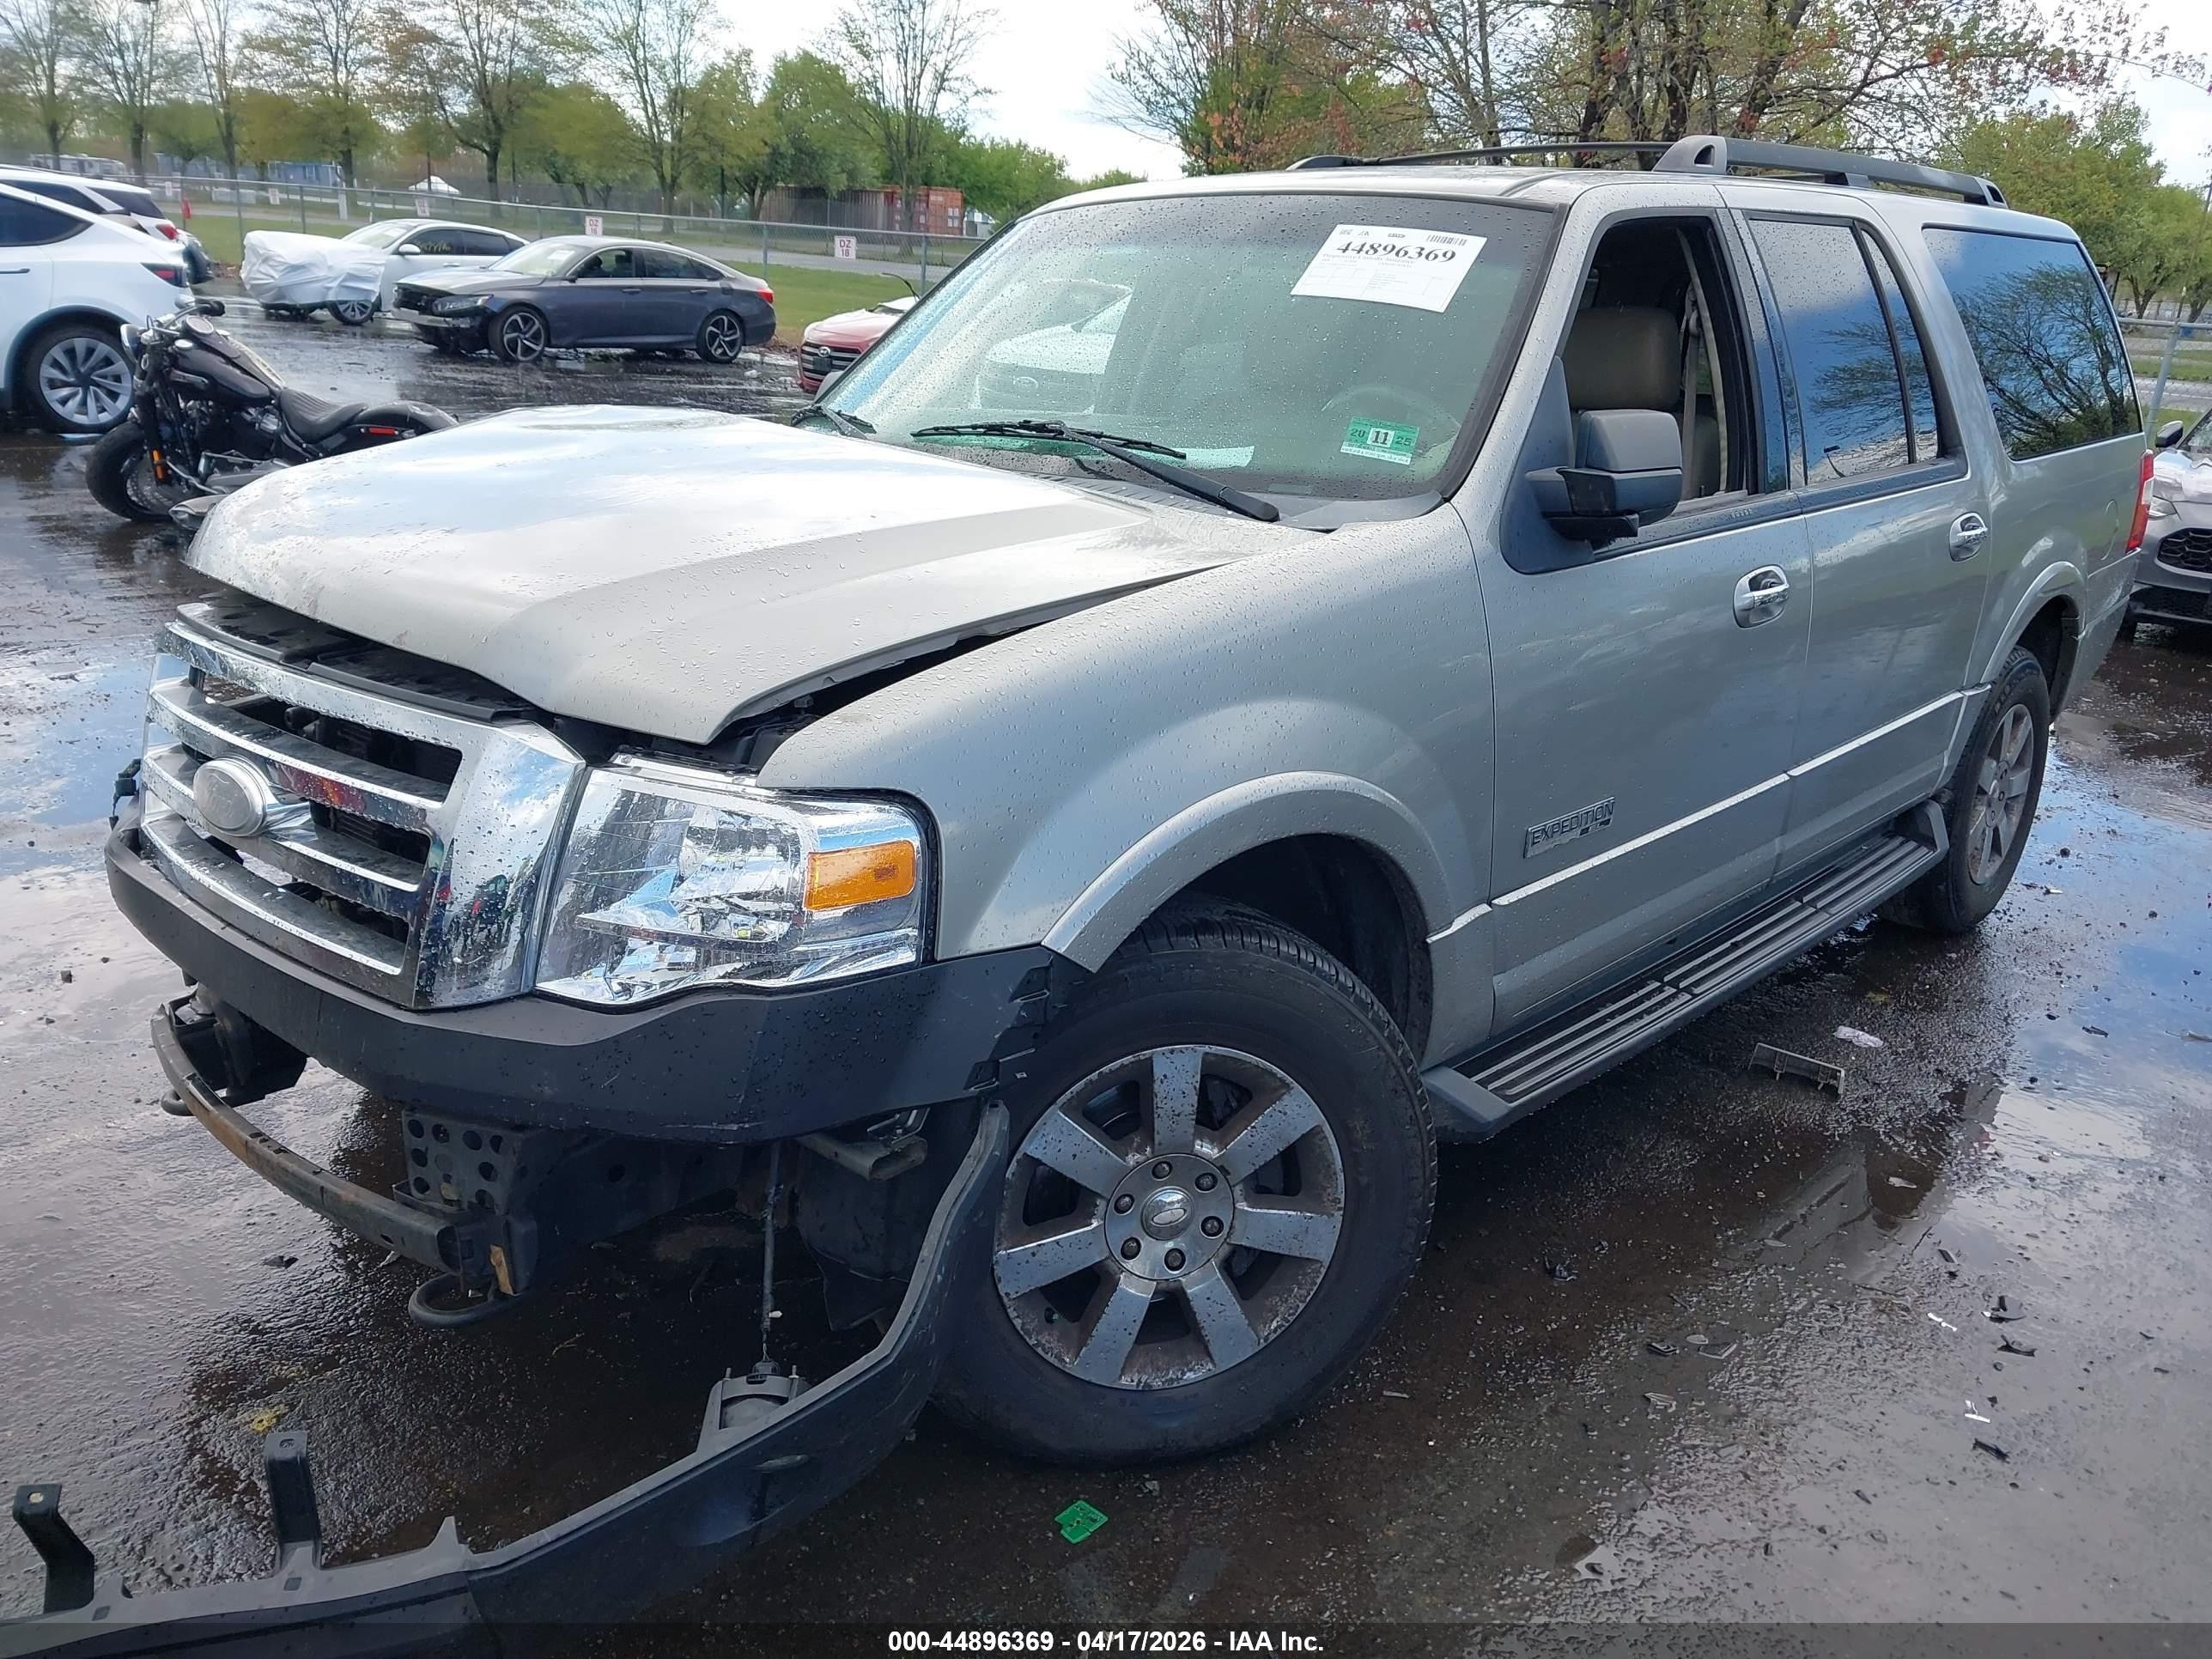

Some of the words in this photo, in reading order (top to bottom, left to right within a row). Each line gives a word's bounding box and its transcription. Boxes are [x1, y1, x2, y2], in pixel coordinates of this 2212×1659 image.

[839, 239, 852, 248] DZ
[1336, 241, 1455, 262] 44896369
[1372, 431, 1389, 445] 11
[1531, 800, 1614, 846] EXPEDITION
